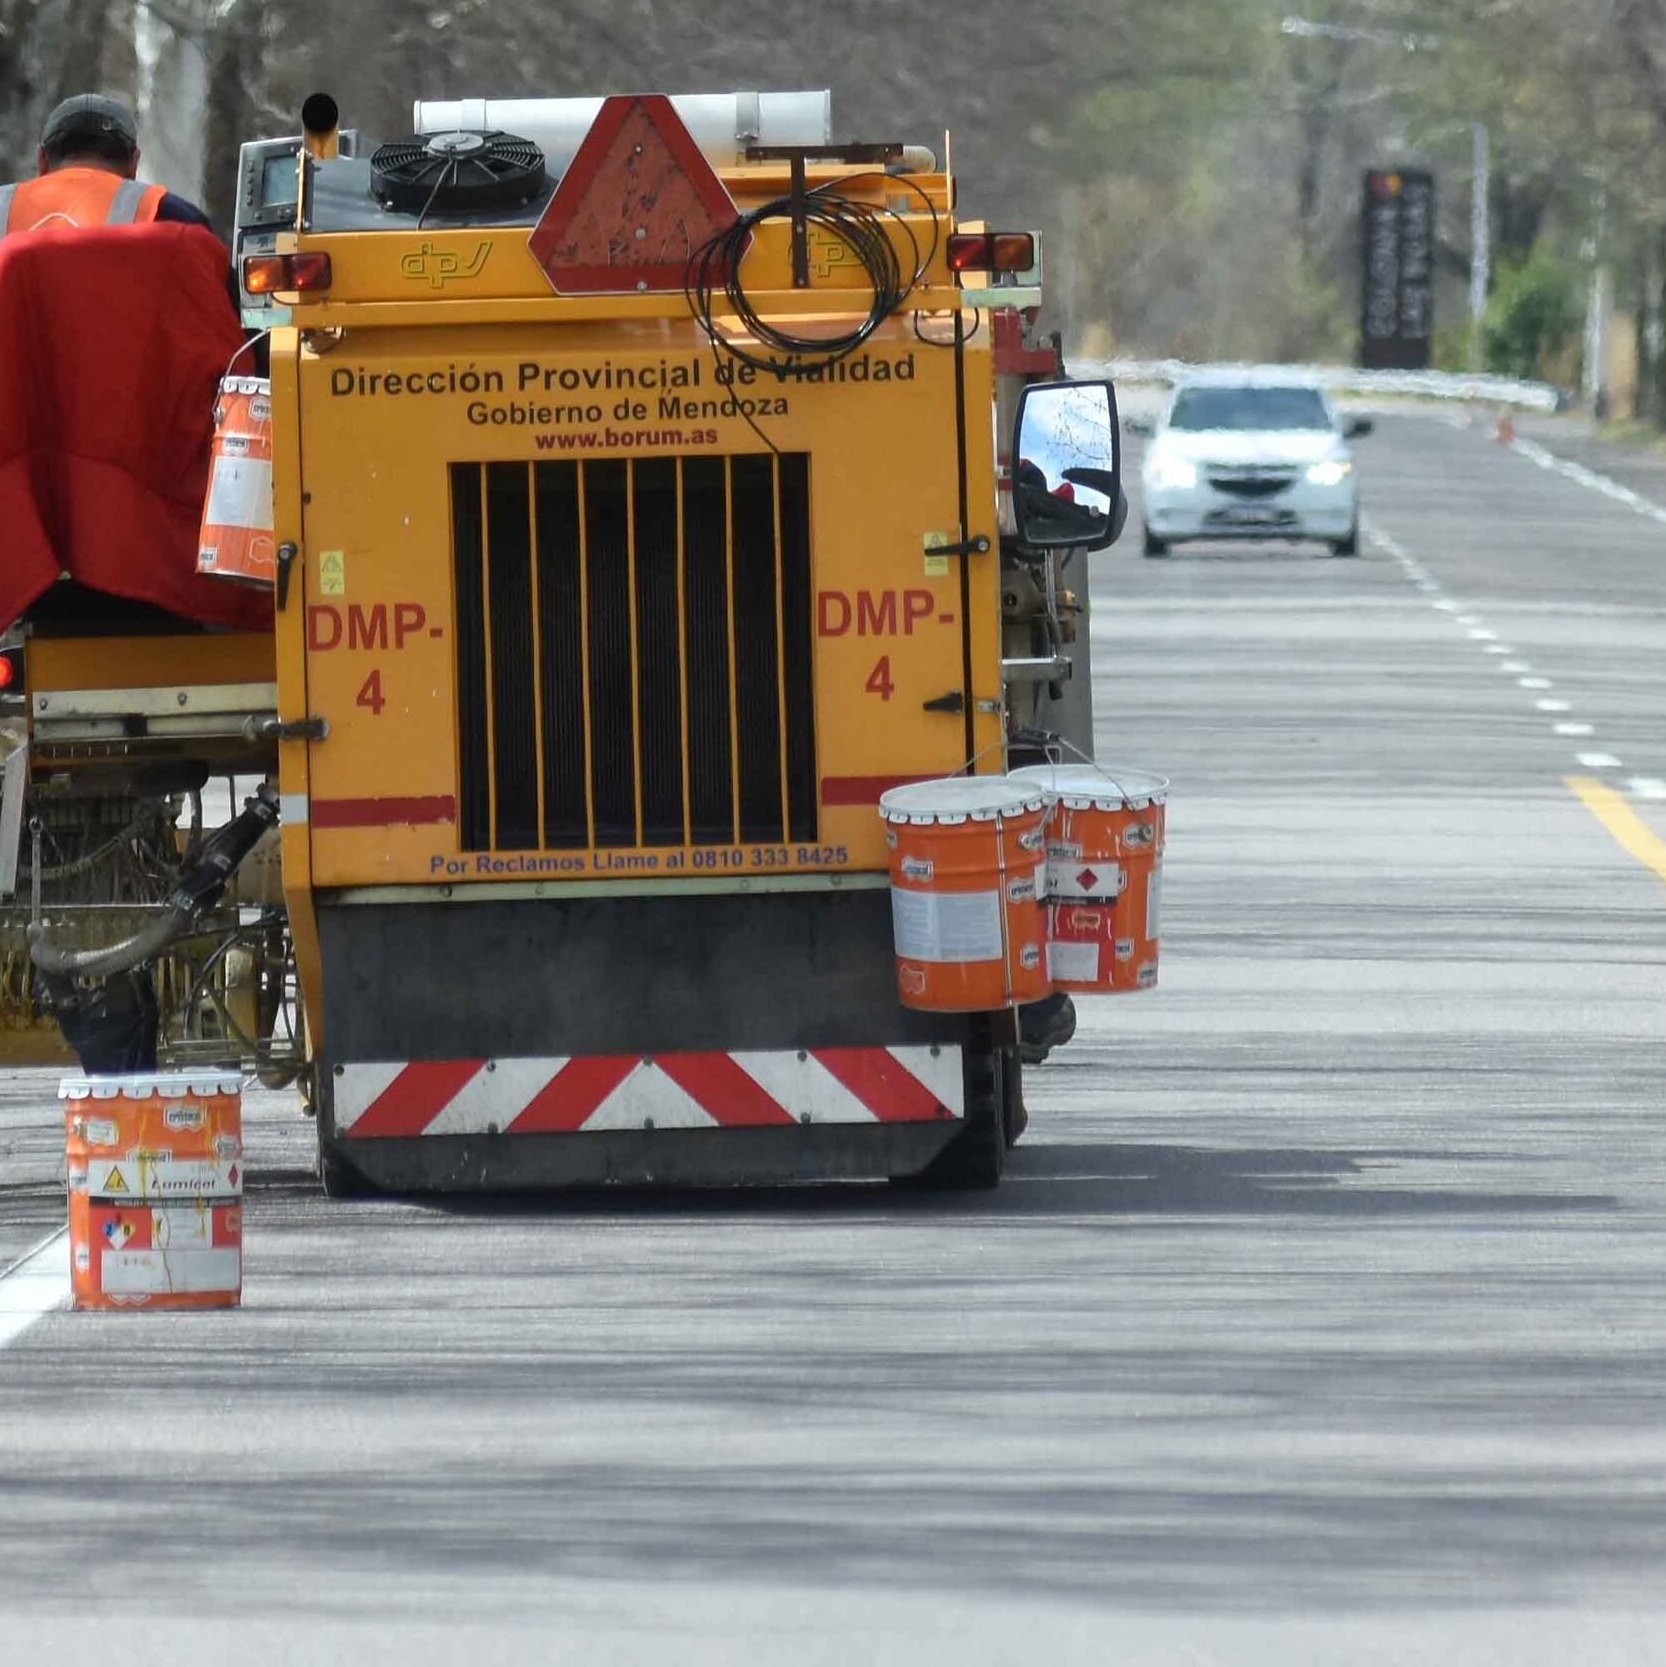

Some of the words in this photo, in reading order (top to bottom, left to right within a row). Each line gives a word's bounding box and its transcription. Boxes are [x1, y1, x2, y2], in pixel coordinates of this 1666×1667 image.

[331, 364, 504, 396] Dirección
[518, 359, 700, 391] Provincial
[715, 354, 757, 386] de
[467, 400, 603, 426] Gobierno
[613, 398, 647, 421] de
[658, 396, 789, 419] Mendoza
[535, 427, 718, 449] www.borum.as
[307, 603, 444, 652] DMP-
[818, 589, 955, 638] DMP-
[355, 669, 386, 716] 4
[865, 655, 895, 702] 4
[430, 855, 468, 875] Por
[476, 853, 586, 874] Reclamos
[593, 851, 659, 871] Llame
[666, 850, 686, 869] al
[692, 848, 744, 869] 0810
[752, 847, 790, 867] 333
[797, 845, 849, 865] 8425
